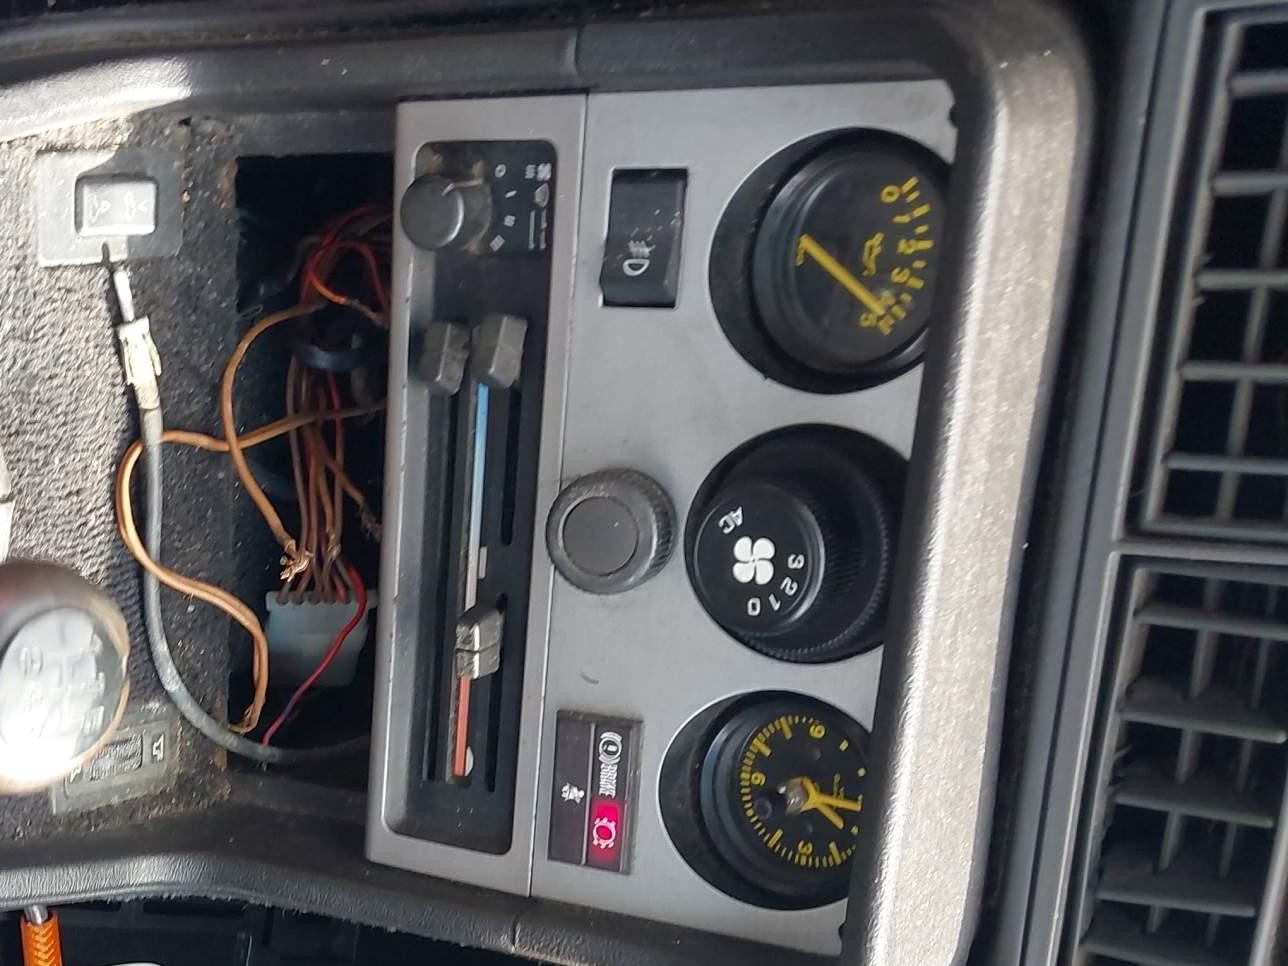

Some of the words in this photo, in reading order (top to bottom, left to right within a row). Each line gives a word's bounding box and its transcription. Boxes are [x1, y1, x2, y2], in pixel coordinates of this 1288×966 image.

[718, 506, 743, 534] AC
[780, 576, 799, 596] 2
[747, 597, 761, 616] 0
[768, 593, 782, 611] 1
[809, 724, 826, 739] 9
[750, 771, 767, 786] 6
